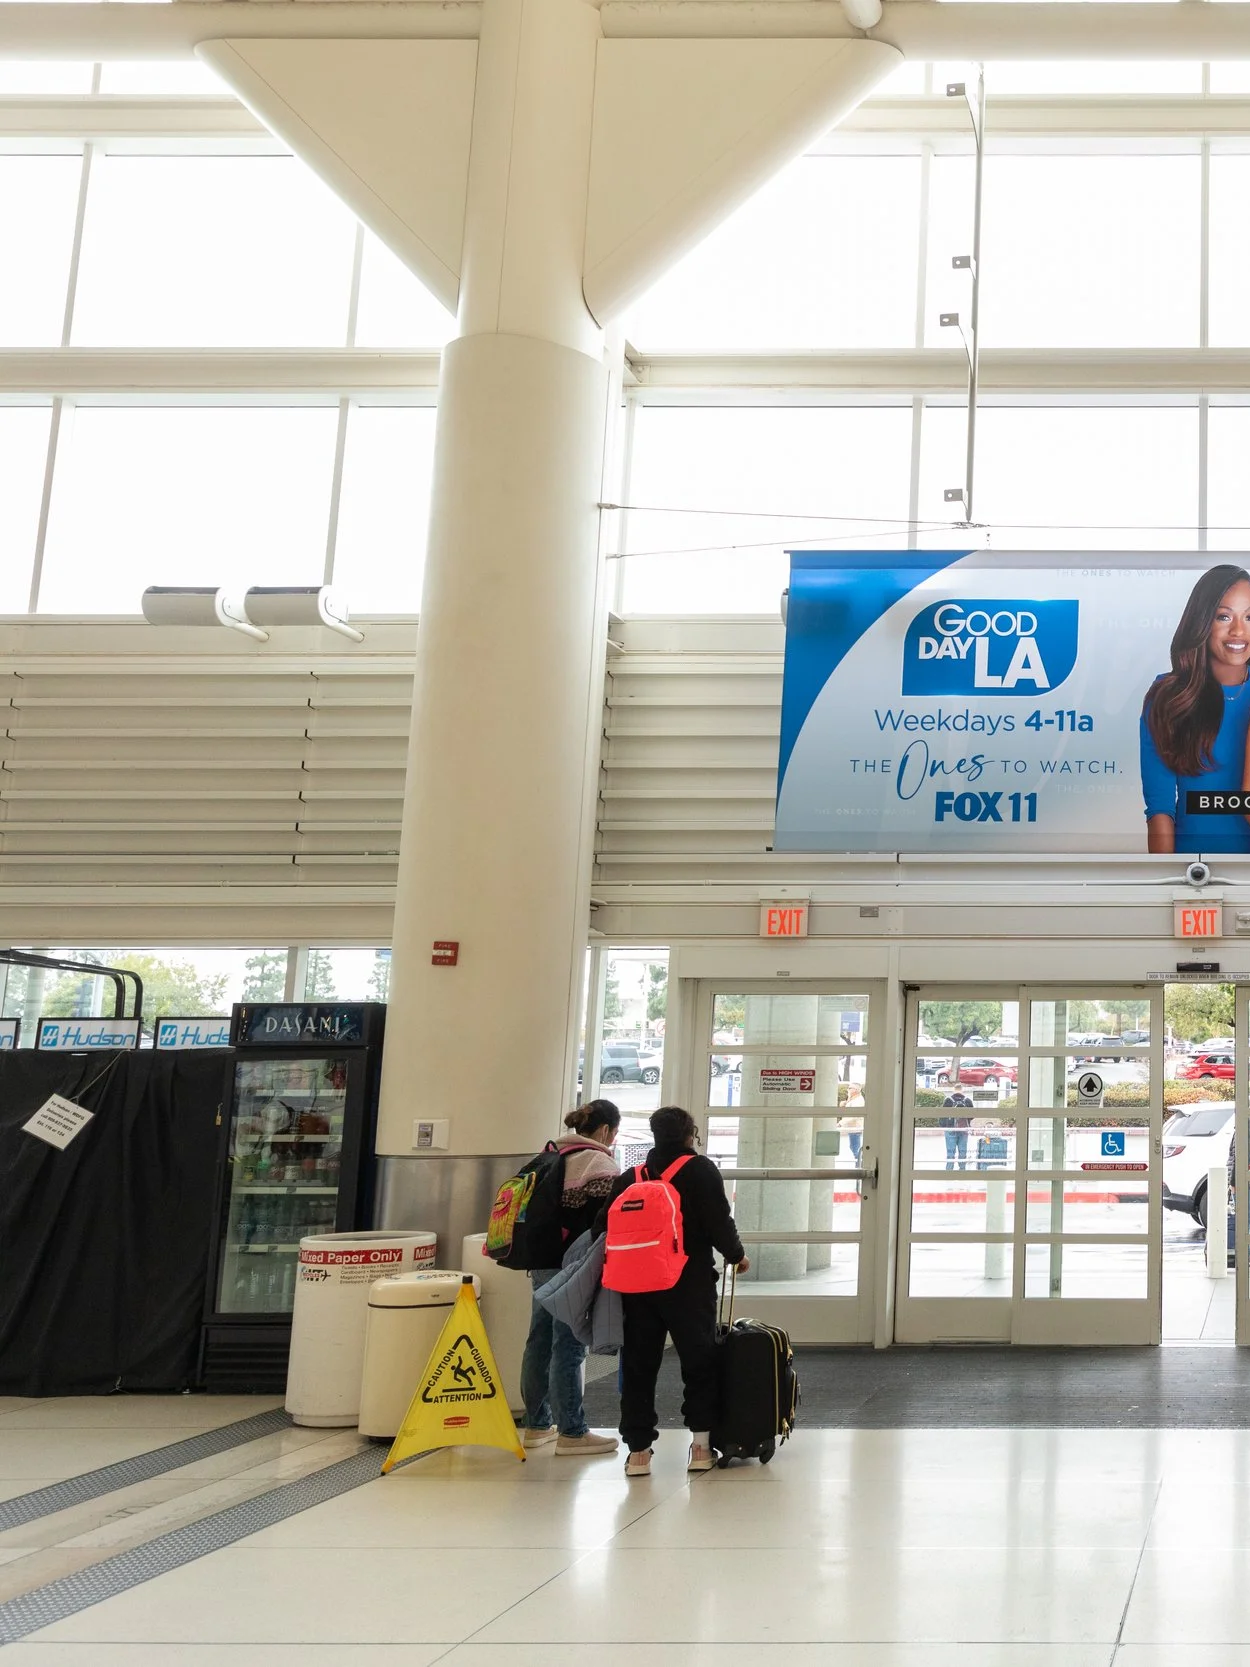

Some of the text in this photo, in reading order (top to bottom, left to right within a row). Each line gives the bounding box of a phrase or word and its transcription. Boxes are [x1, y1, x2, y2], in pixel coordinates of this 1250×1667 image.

[934, 604, 1038, 637] GOOD
[918, 637, 1051, 688] DAY LA
[874, 708, 1094, 735] Weekdays 4-11a
[850, 739, 1124, 800] THE Ones TO WATCH.
[935, 791, 1037, 822] FOX 11
[767, 909, 804, 935] EXIT
[1182, 909, 1217, 936] EXIT
[61, 1026, 136, 1046] Hudson
[180, 1026, 231, 1046] Huds
[265, 1011, 341, 1037] DASANI
[302, 1250, 402, 1266] Mixed Paper Only
[428, 1348, 455, 1387] CAUTION
[470, 1347, 492, 1384] CUIDADO
[432, 1393, 482, 1404] ATTENTION
